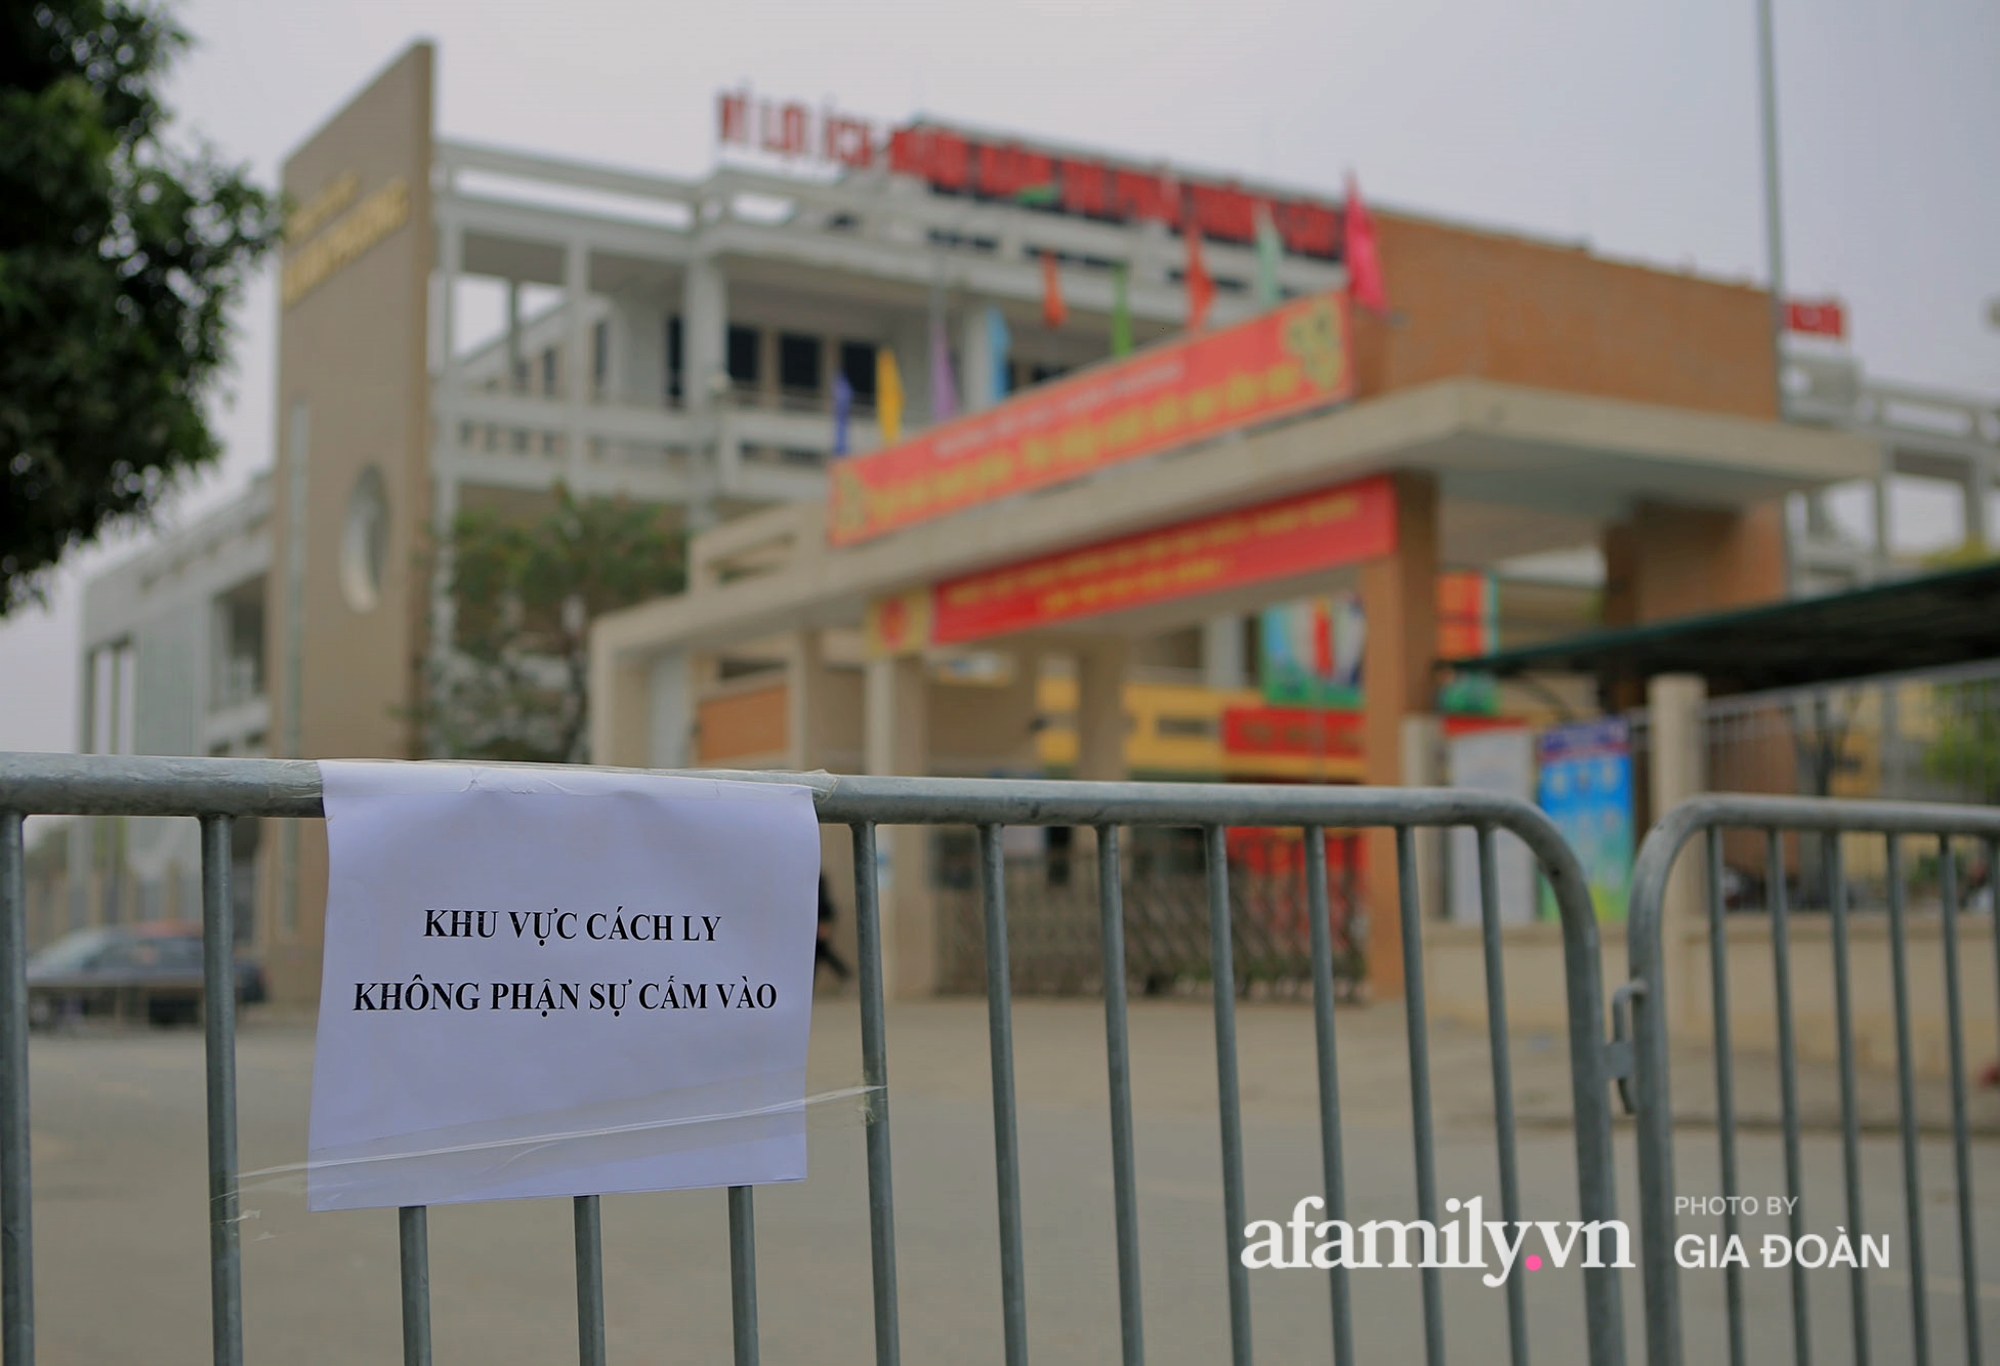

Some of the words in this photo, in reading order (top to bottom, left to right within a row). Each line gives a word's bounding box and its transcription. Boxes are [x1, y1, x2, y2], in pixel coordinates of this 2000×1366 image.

[424, 909, 498, 938] KHU
[508, 908, 577, 946] VỰC
[587, 906, 673, 941] CÁCH
[683, 915, 721, 942] LY
[353, 974, 480, 1010] KHÔNG
[491, 978, 580, 1017] PHẬN
[590, 979, 633, 1017] SỰ
[639, 976, 706, 1009] CẤM
[716, 976, 777, 1009] VÀO
